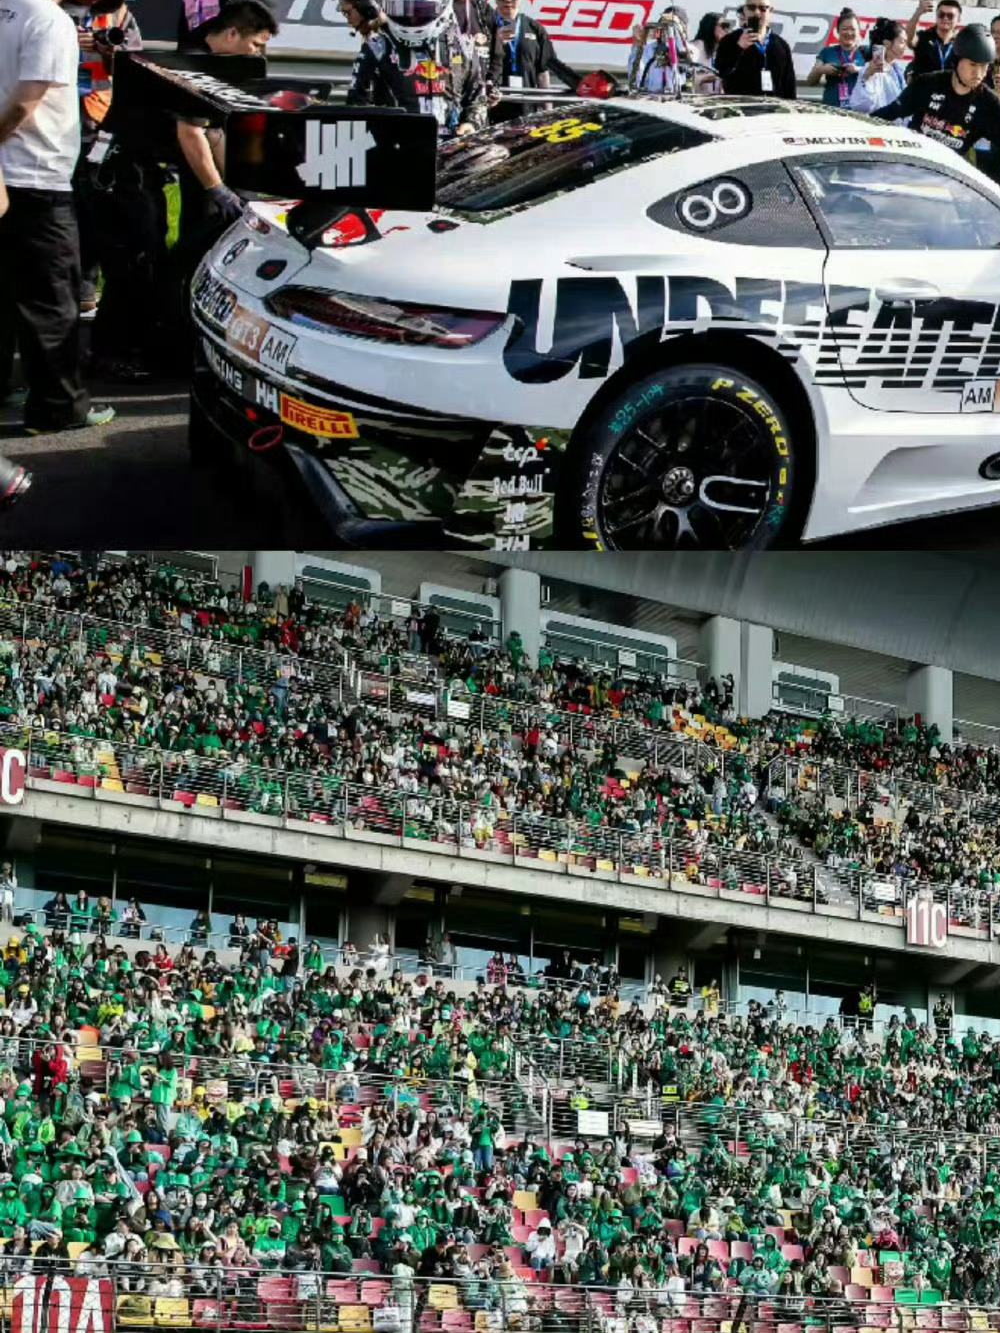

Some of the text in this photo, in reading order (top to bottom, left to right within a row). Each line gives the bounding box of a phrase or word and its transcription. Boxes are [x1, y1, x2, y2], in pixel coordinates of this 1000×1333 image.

[805, 137, 866, 145] MELVIN
[261, 336, 290, 364] AM
[964, 387, 992, 405] AM
[281, 396, 353, 435] PIRELLI
[711, 377, 790, 456] P ZERO
[518, 474, 544, 494] Bull
[907, 899, 948, 948] 11C
